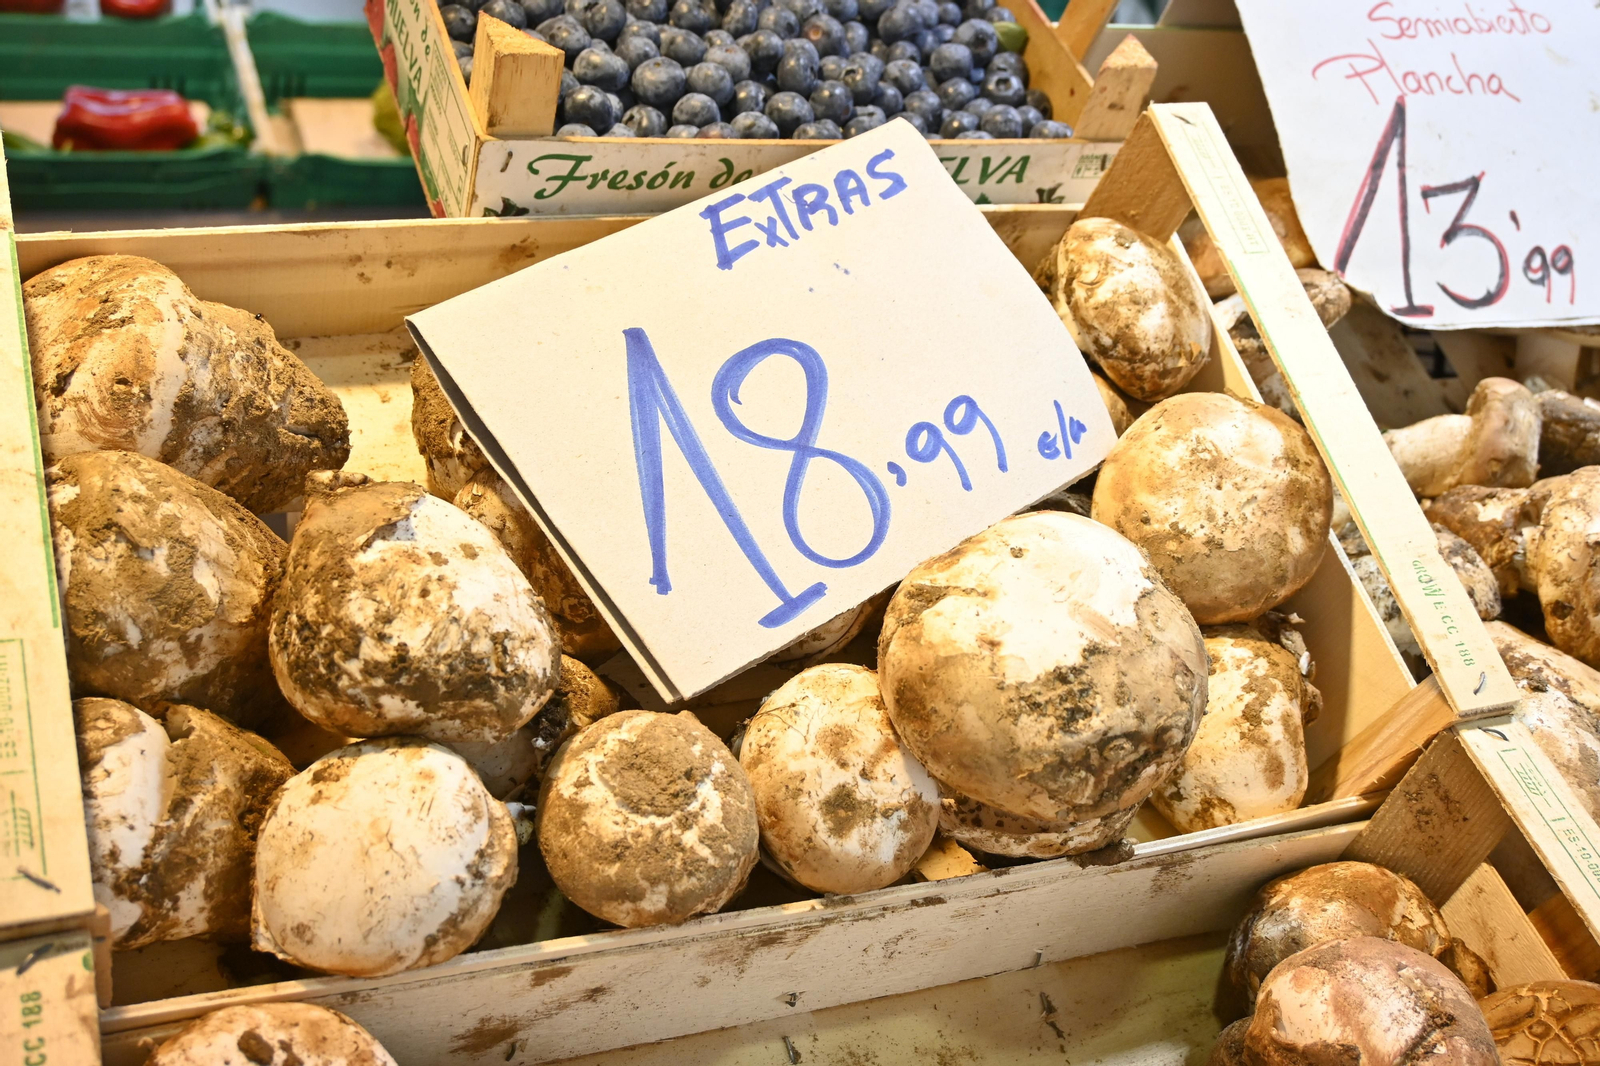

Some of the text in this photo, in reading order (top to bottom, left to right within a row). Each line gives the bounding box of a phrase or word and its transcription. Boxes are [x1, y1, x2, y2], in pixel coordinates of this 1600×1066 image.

[1311, 38, 1522, 105] Plancha
[527, 154, 695, 199] Fresón
[1412, 560, 1445, 596] GROW
[1455, 641, 1475, 667] 188
[20, 990, 42, 1029] 188
